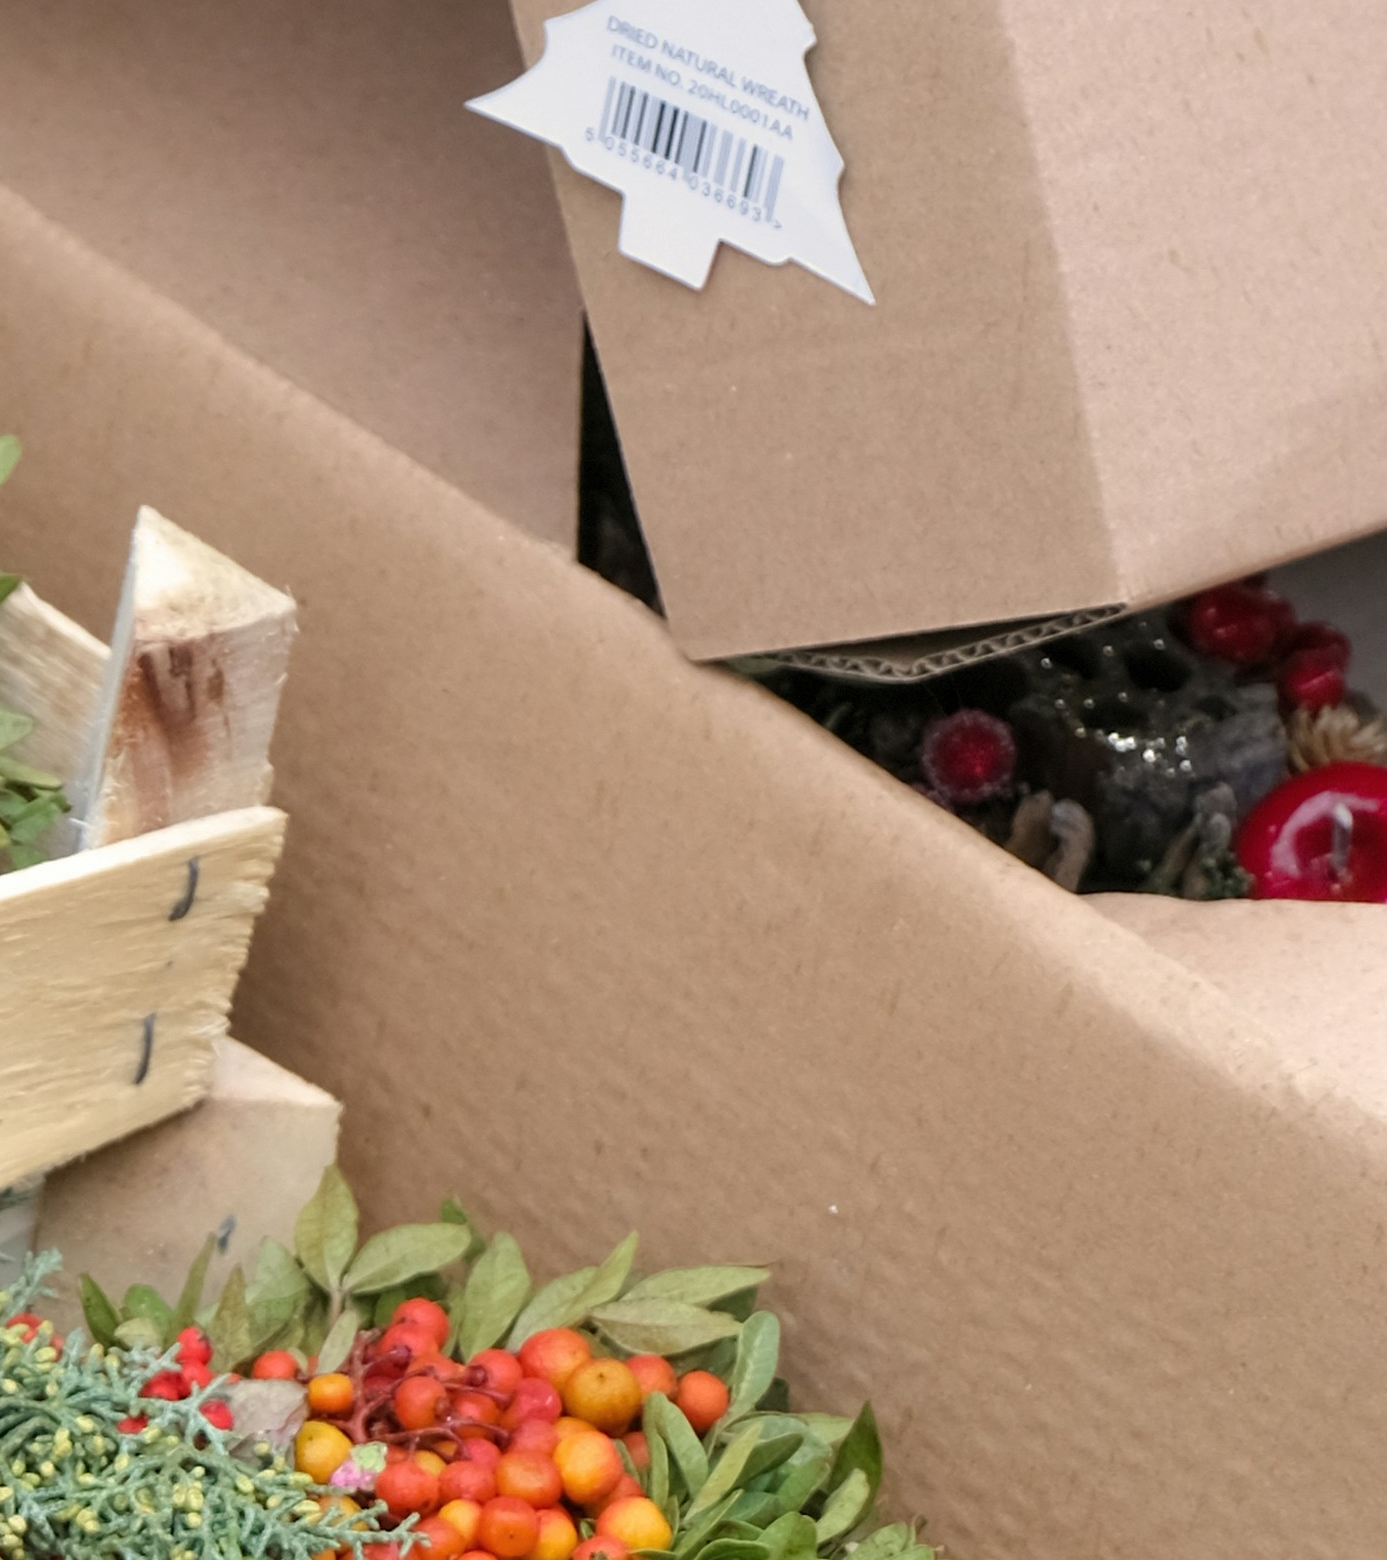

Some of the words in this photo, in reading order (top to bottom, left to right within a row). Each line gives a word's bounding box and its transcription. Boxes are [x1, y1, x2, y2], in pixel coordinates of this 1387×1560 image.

[606, 15, 659, 50] DRIED
[661, 40, 738, 89] NATURAL
[741, 77, 811, 122] WREATH
[611, 43, 653, 74] ITEM
[655, 62, 685, 90] NO.
